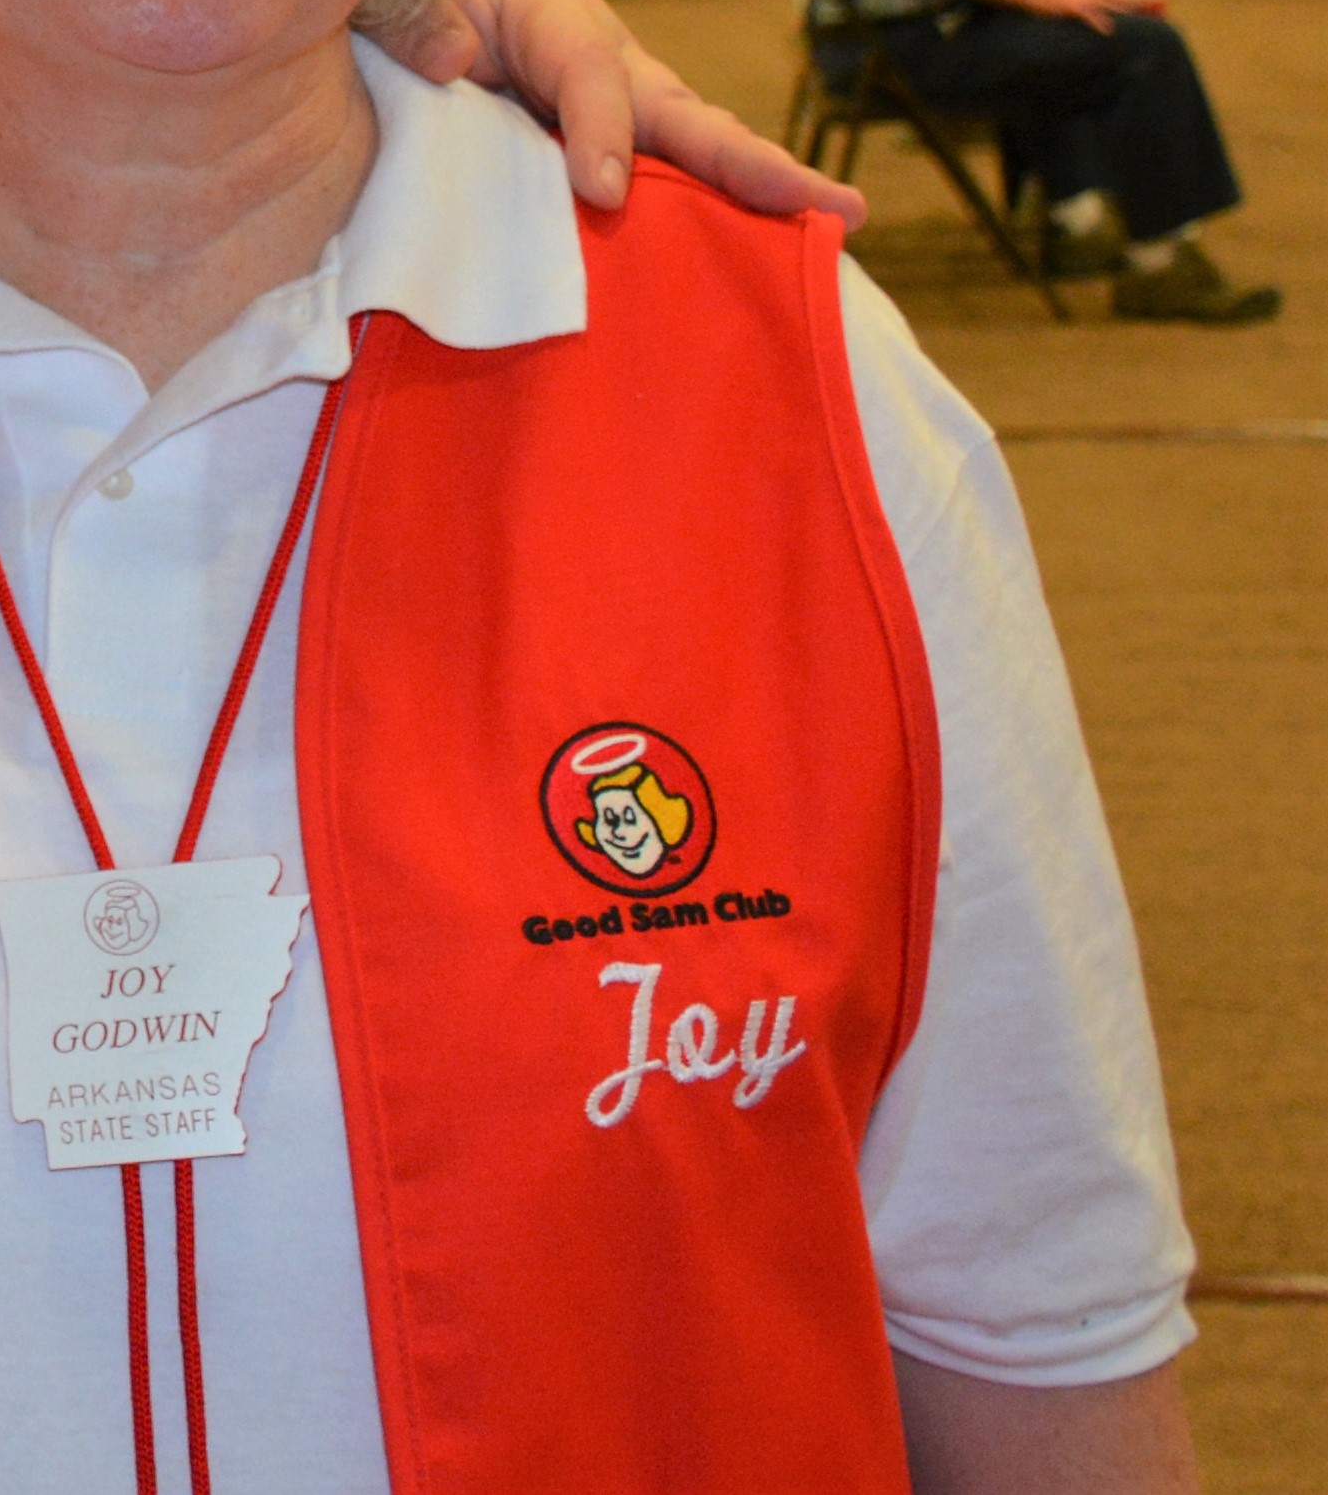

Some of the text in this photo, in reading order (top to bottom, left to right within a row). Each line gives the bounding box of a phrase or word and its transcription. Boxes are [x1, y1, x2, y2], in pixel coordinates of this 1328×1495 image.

[522, 889, 792, 946] Good Sam Club
[100, 964, 176, 999] JOY
[52, 1011, 222, 1054] GODWIN
[585, 961, 808, 1128] Joy
[47, 1072, 222, 1109] ARKANSAS
[59, 1108, 218, 1145] STATE STAFF
